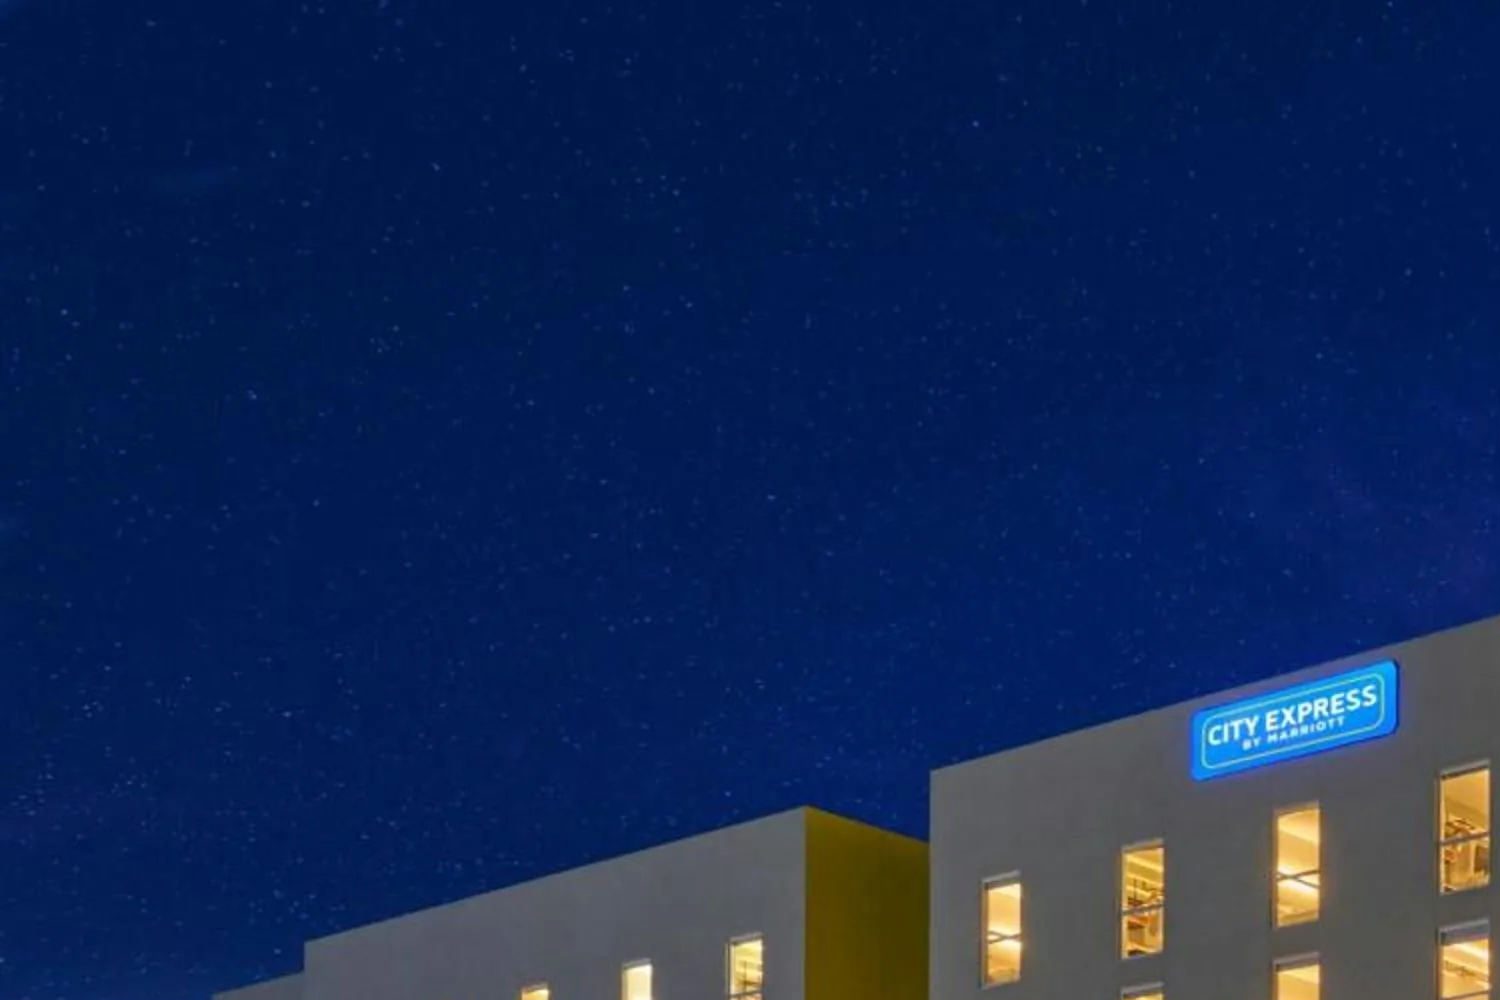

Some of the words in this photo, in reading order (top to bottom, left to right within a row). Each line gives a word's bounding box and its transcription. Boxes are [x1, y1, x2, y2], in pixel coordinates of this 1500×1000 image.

[1208, 715, 1259, 745] CITY
[1265, 684, 1377, 732] EXPRESS
[1242, 736, 1261, 751] BY
[1267, 715, 1345, 744] MARRIOTT
